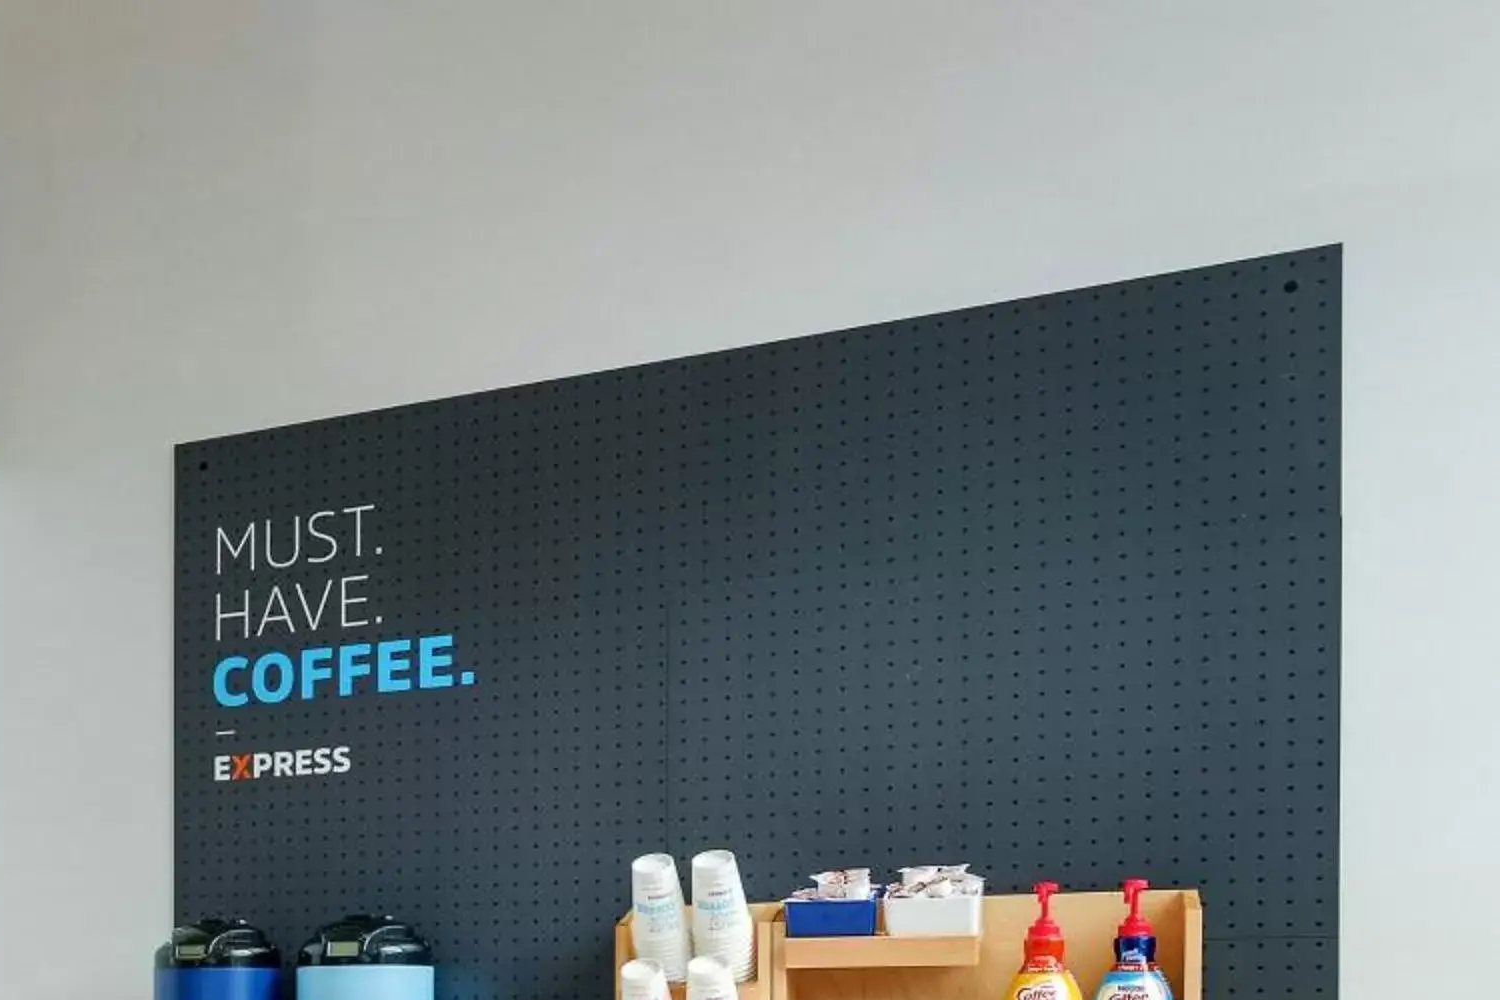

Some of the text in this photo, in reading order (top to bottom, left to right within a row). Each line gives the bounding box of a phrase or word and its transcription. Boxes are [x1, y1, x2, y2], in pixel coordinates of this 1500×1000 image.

[216, 504, 383, 575] MUST.
[216, 575, 383, 641] HAVE.
[212, 634, 475, 708] COFFEE.
[214, 746, 351, 781] EXPRESS
